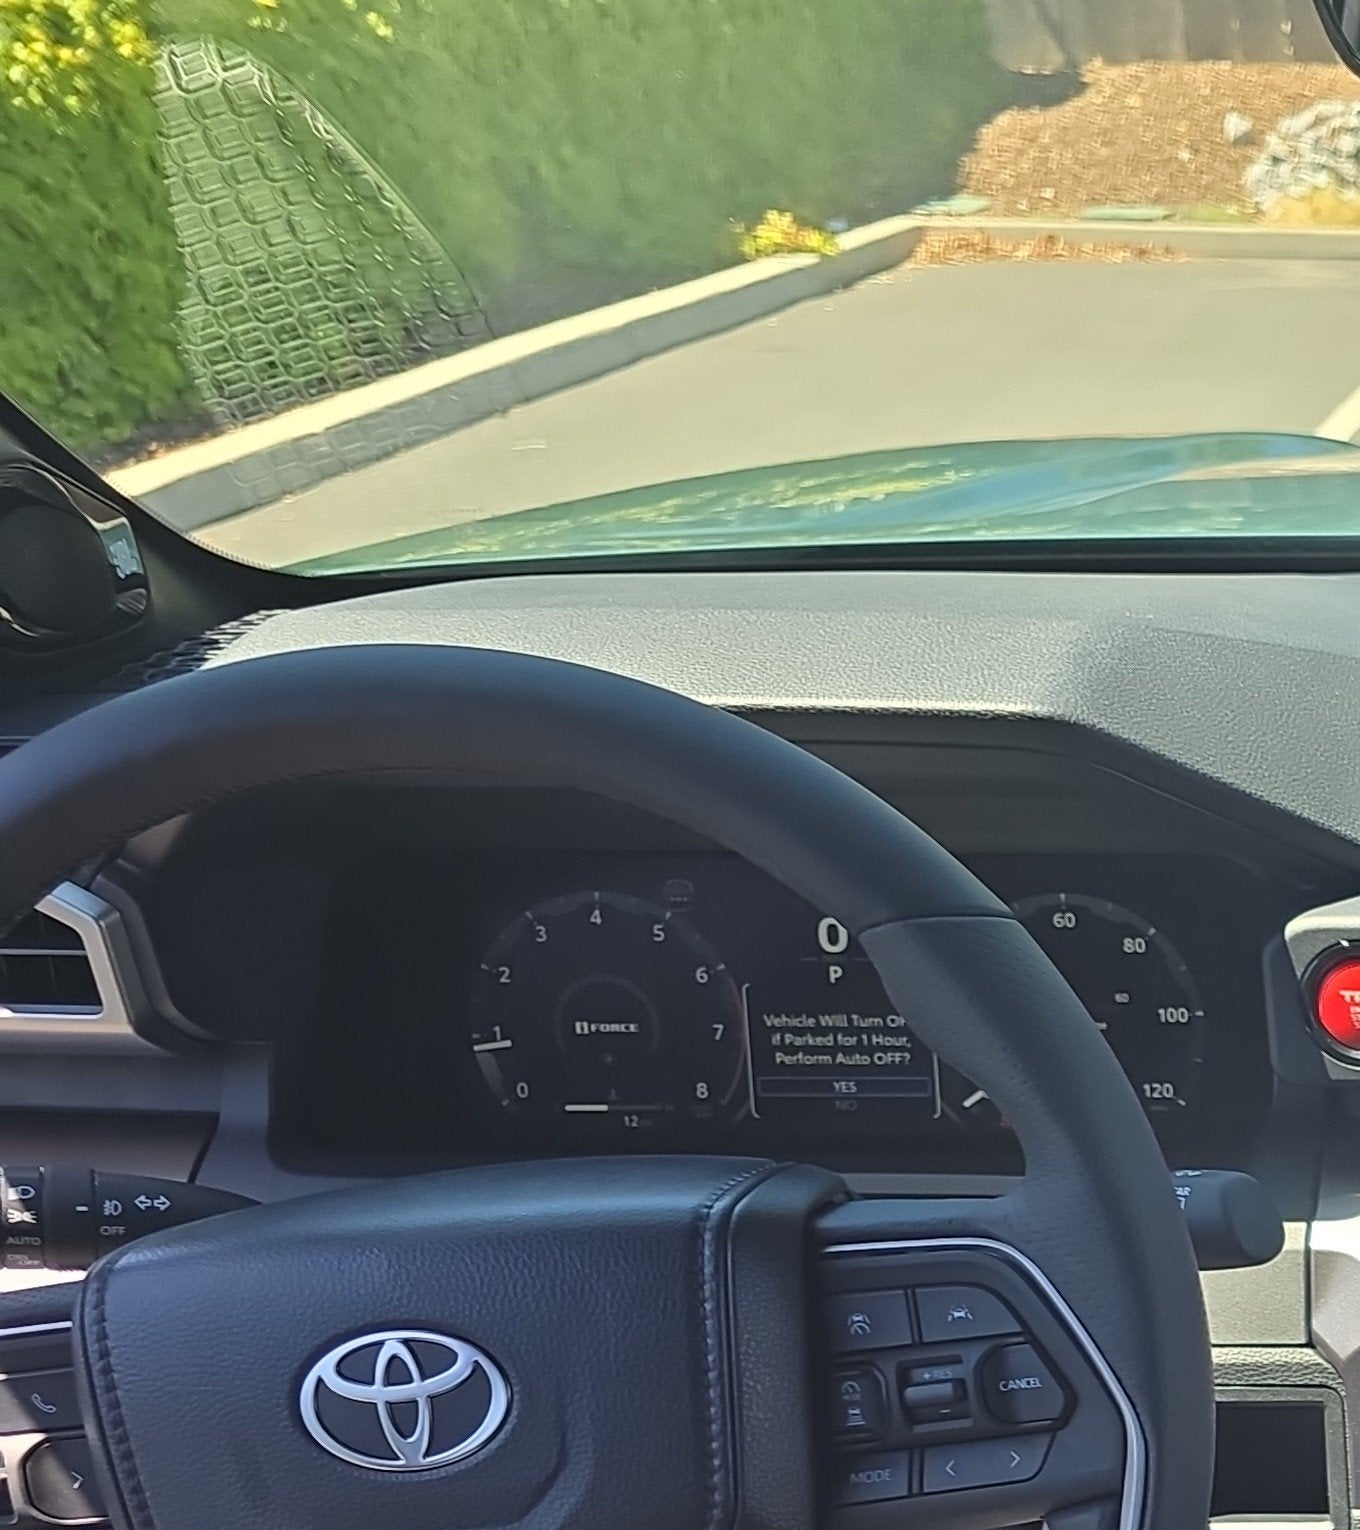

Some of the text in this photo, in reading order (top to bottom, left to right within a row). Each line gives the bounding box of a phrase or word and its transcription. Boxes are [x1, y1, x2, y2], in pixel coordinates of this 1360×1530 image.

[589, 909, 603, 925] 4
[1052, 912, 1077, 928] 60
[534, 925, 548, 942] 3
[653, 924, 665, 942] 5
[818, 917, 849, 953] 0
[1122, 937, 1146, 954] 80
[497, 967, 511, 983] 2
[695, 967, 709, 984] 6
[829, 965, 843, 983] P
[763, 1014, 884, 1027] Vehicle Will Turn
[1158, 1007, 1189, 1023] 100
[712, 1024, 725, 1041] 7
[785, 1032, 911, 1048] Parked for 1 Hour,
[775, 1052, 911, 1066] Perform Auto OFF?
[516, 1082, 529, 1099] 0
[696, 1082, 709, 1099] 8
[833, 1081, 857, 1093] YES
[1143, 1083, 1174, 1099] 120
[836, 1099, 857, 1111] NO
[100, 1226, 126, 1236] OFF
[6, 1236, 41, 1246] AUTO
[999, 1377, 1042, 1392] CANCEL
[850, 1468, 892, 1483] MODE
